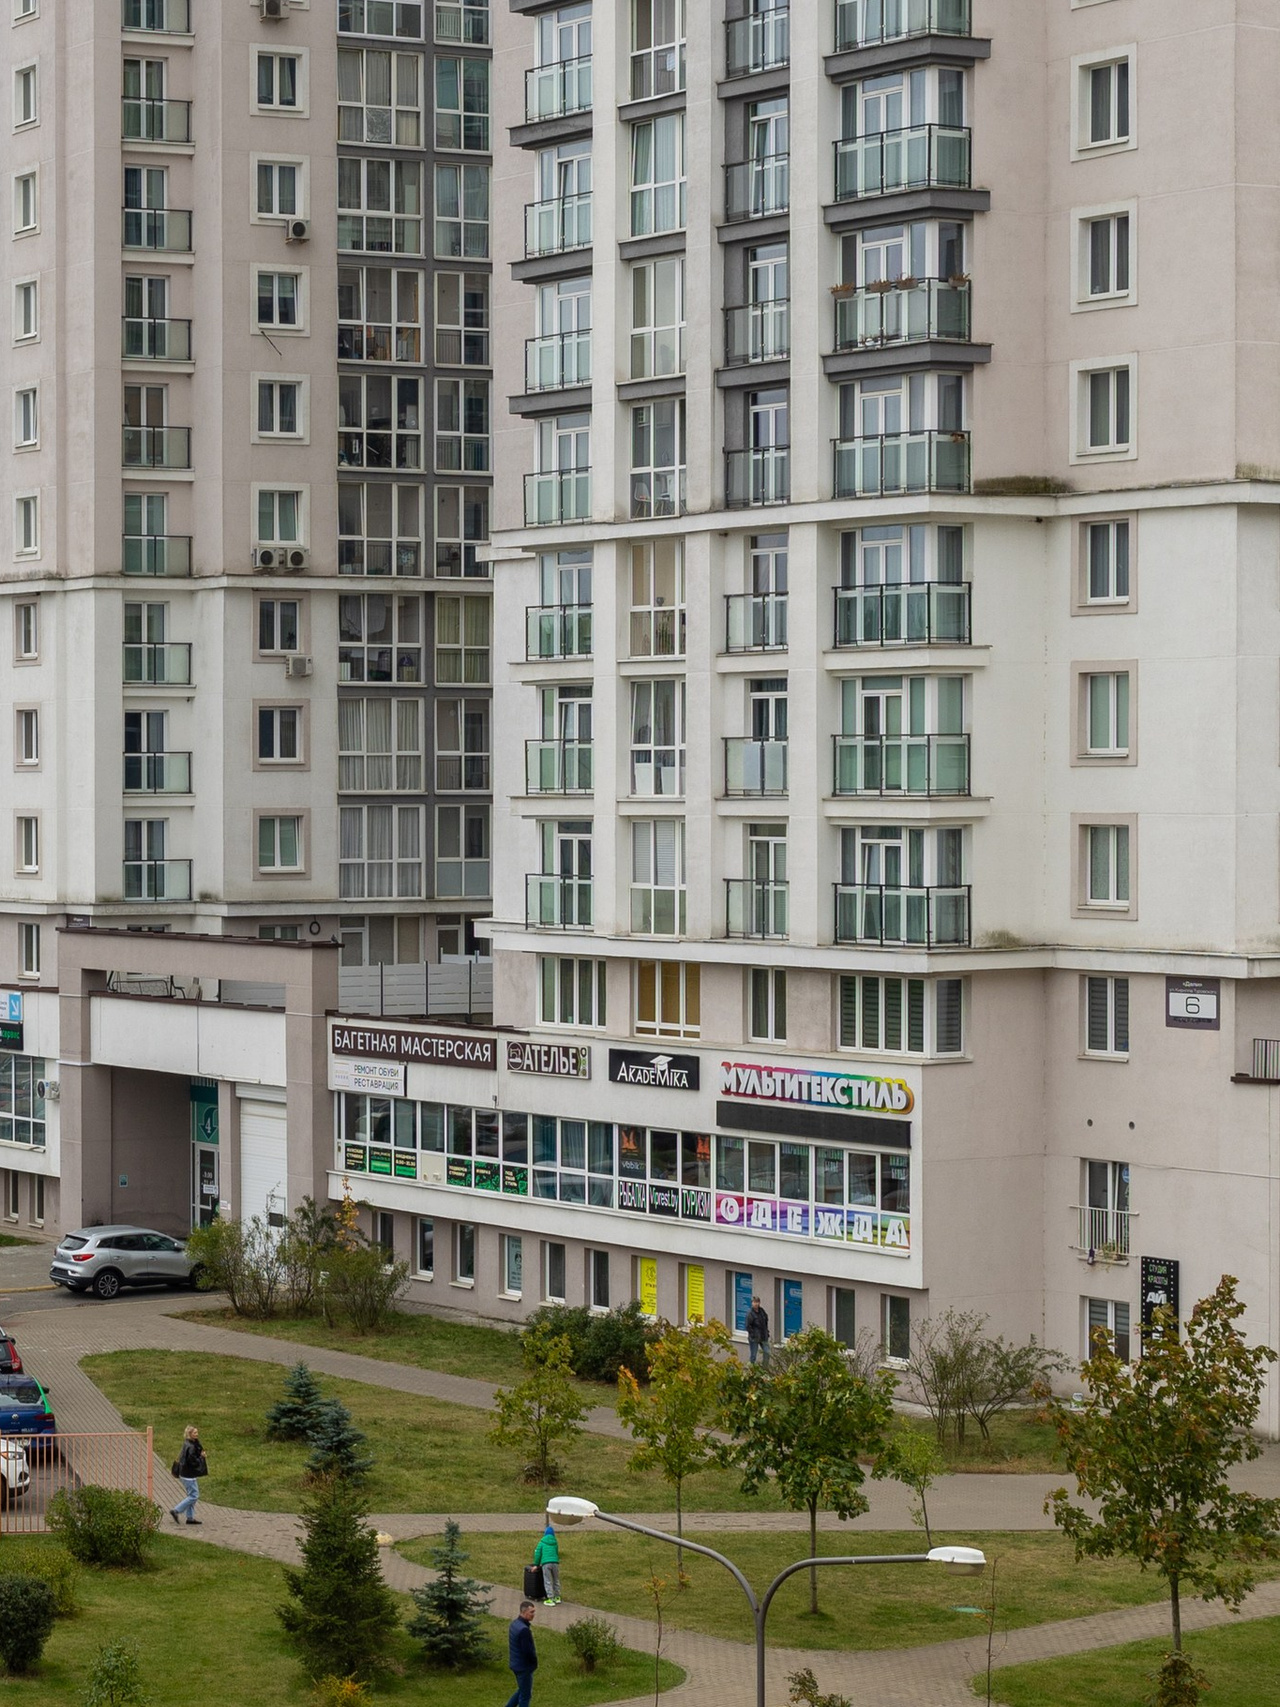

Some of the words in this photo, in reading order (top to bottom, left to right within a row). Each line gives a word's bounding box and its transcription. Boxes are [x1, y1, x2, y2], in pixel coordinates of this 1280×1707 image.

[1185, 996, 1200, 1014] 6
[334, 1030, 397, 1051] БАГЕТНАЯ
[401, 1036, 491, 1062] МАСТЕРСКАЯ
[354, 1064, 377, 1076] РЕМОНТ
[378, 1067, 399, 1078] ОБУВИ
[523, 1047, 578, 1075] АТЕЛЬЕ
[354, 1078, 399, 1091] РЕСТАВРАЦИЯ
[720, 1064, 909, 1111] МУЛЬТИТЕКСТИЛЬ
[205, 1117, 211, 1133] 4
[619, 1181, 646, 1208] РЫБАЛКА
[682, 1189, 711, 1217] ТУРИЗМ
[720, 1197, 909, 1246] ОДЕЖДА
